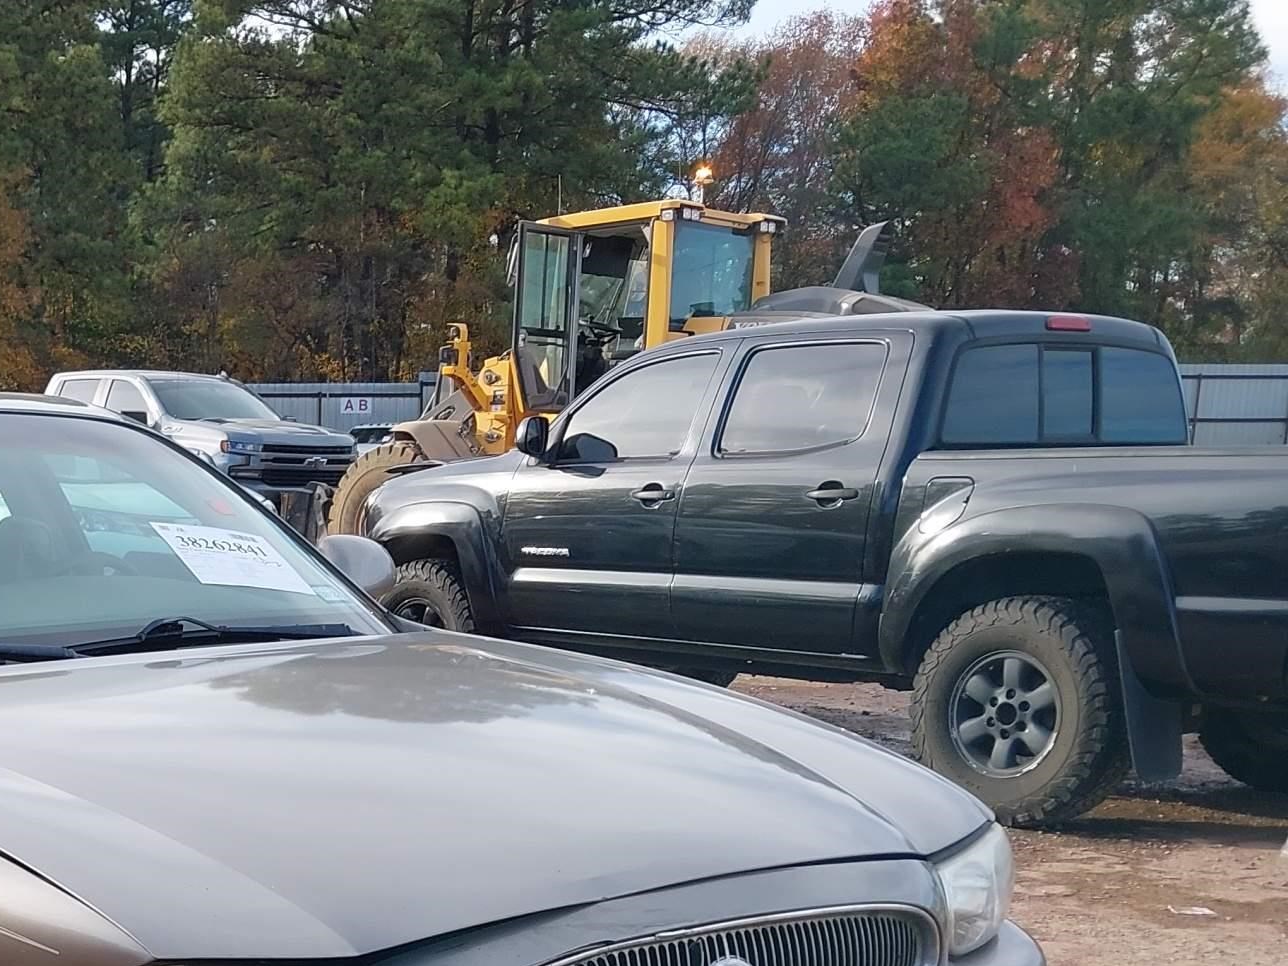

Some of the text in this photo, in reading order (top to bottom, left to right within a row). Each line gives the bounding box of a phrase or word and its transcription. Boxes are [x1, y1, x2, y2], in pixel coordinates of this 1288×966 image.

[343, 399, 368, 412] A B
[175, 535, 269, 558] 38262841
